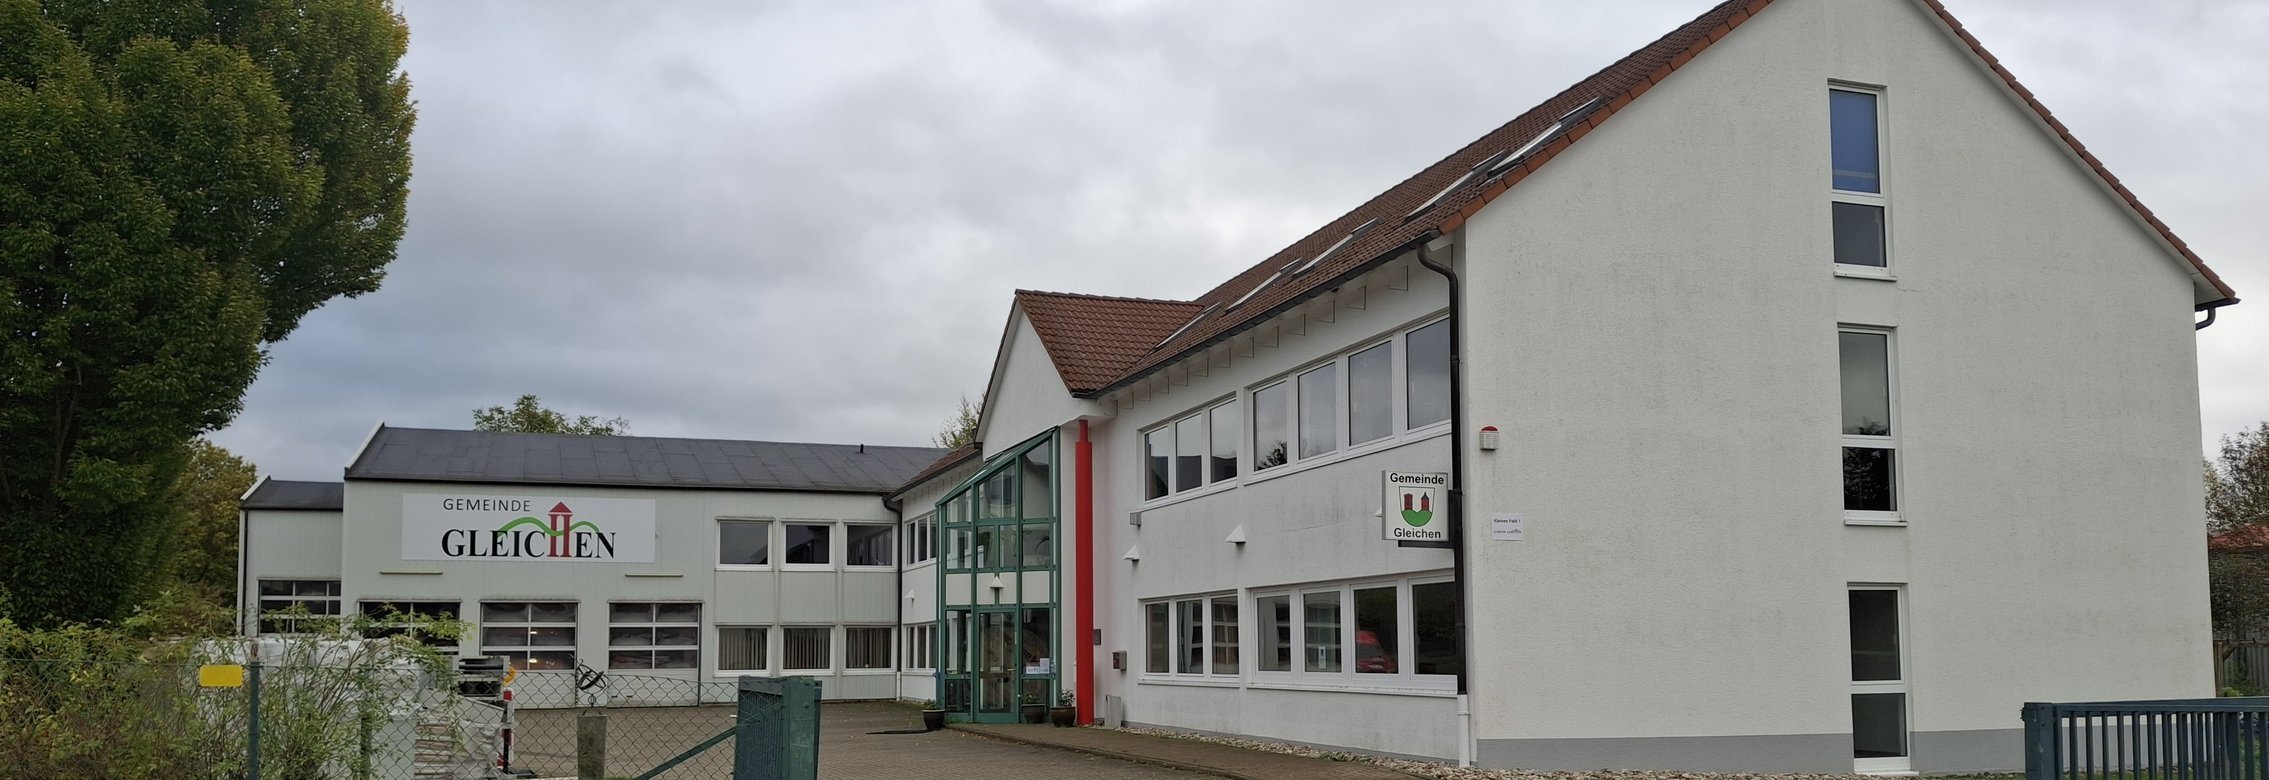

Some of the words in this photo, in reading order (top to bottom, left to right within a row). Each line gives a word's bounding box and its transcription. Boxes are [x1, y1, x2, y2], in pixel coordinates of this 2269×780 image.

[1390, 472, 1445, 485] Gemeinde
[443, 498, 531, 512] GEMEINDE
[1393, 527, 1441, 539] Gleichen
[441, 526, 617, 559] GLEICHEN
